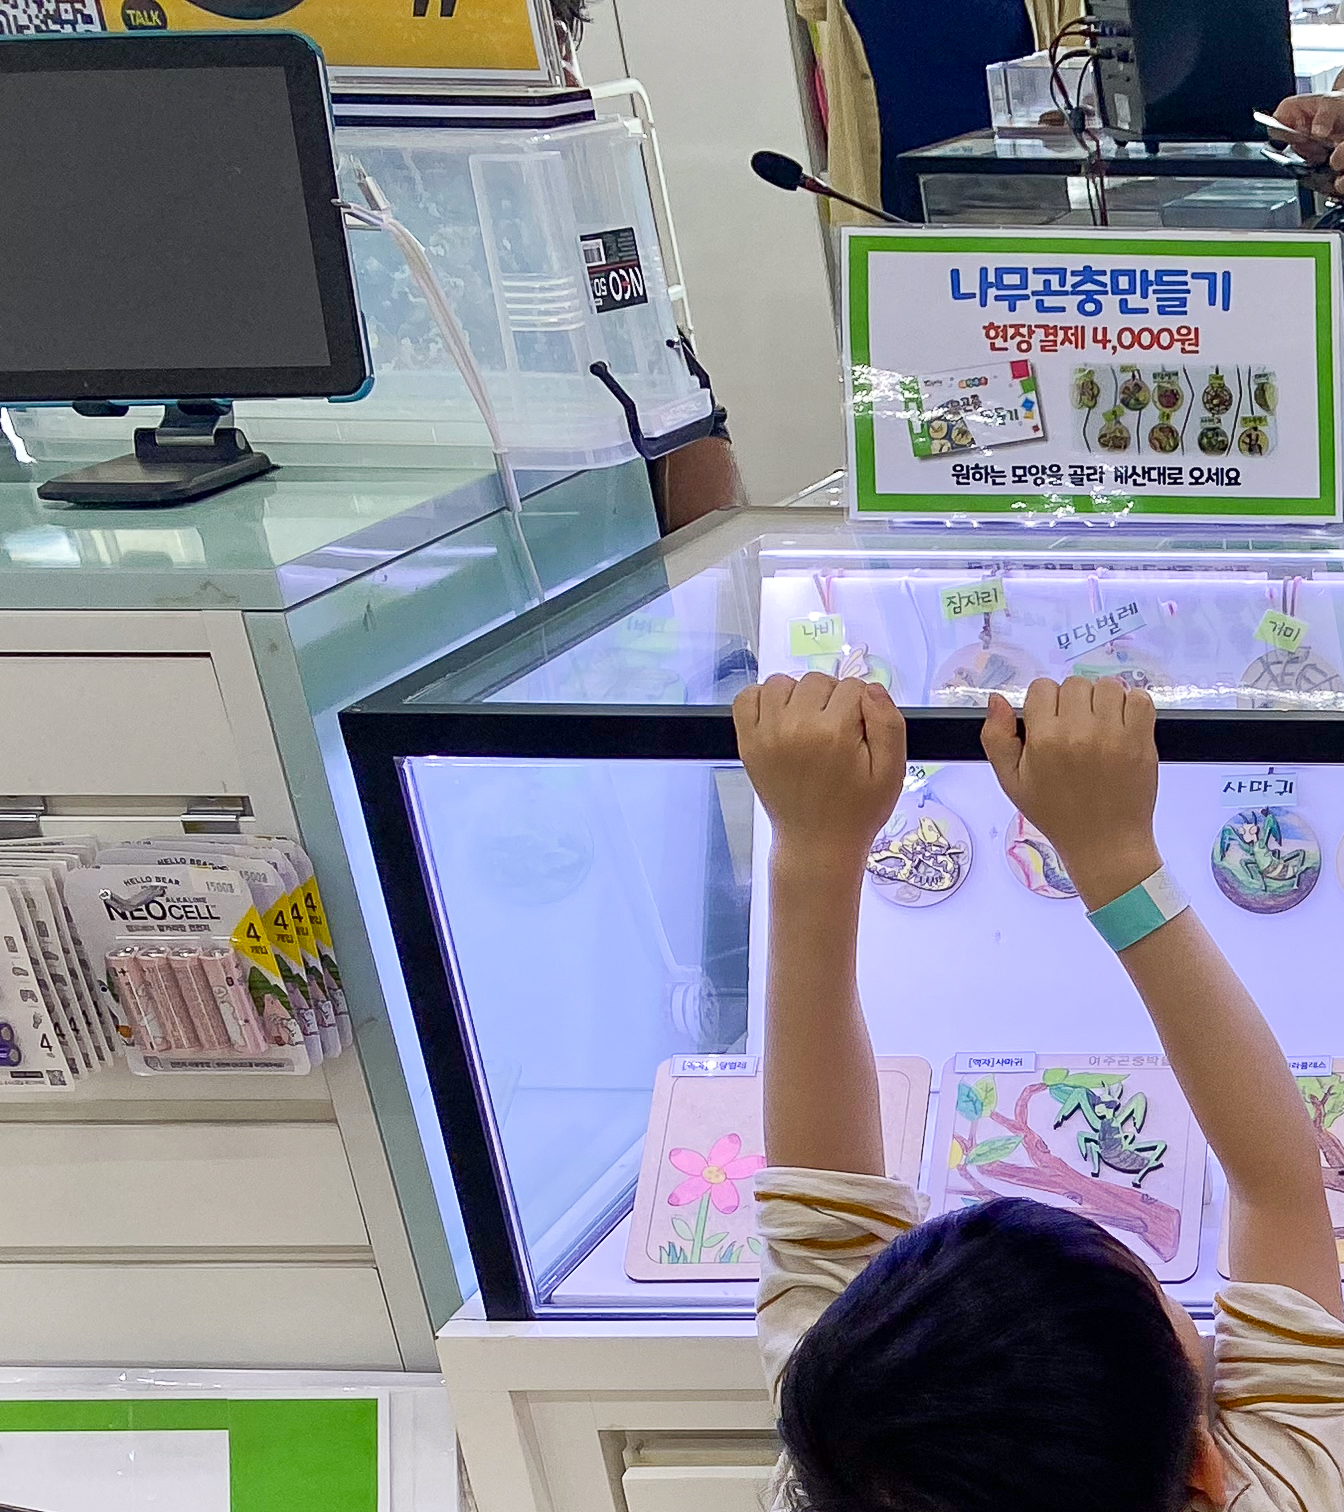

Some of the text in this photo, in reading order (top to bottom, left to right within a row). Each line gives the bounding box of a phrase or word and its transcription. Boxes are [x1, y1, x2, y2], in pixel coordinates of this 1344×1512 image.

[126, 8, 162, 28] TALK
[950, 265, 1232, 317] 나무곤충만들기
[982, 321, 1201, 356] 현장결제 4,000원
[951, 463, 1007, 488] 원하는
[1011, 464, 1064, 487] 모양을
[1067, 464, 1106, 486] 골라
[1188, 465, 1243, 487] 오세요
[946, 587, 999, 615] 잠자리
[802, 617, 836, 638] 나비
[1056, 601, 1140, 651] 무당벌레
[1268, 619, 1302, 643] 거미
[1222, 777, 1295, 796] 사마귀
[123, 875, 152, 887] HELLO
[154, 875, 182, 887] BEAR
[290, 902, 304, 923] 4
[305, 892, 318, 912] 4
[273, 910, 289, 931] 4
[246, 922, 262, 943] 4
[40, 1033, 53, 1051] 4
[967, 1056, 1024, 1068] [액자]사마귀
